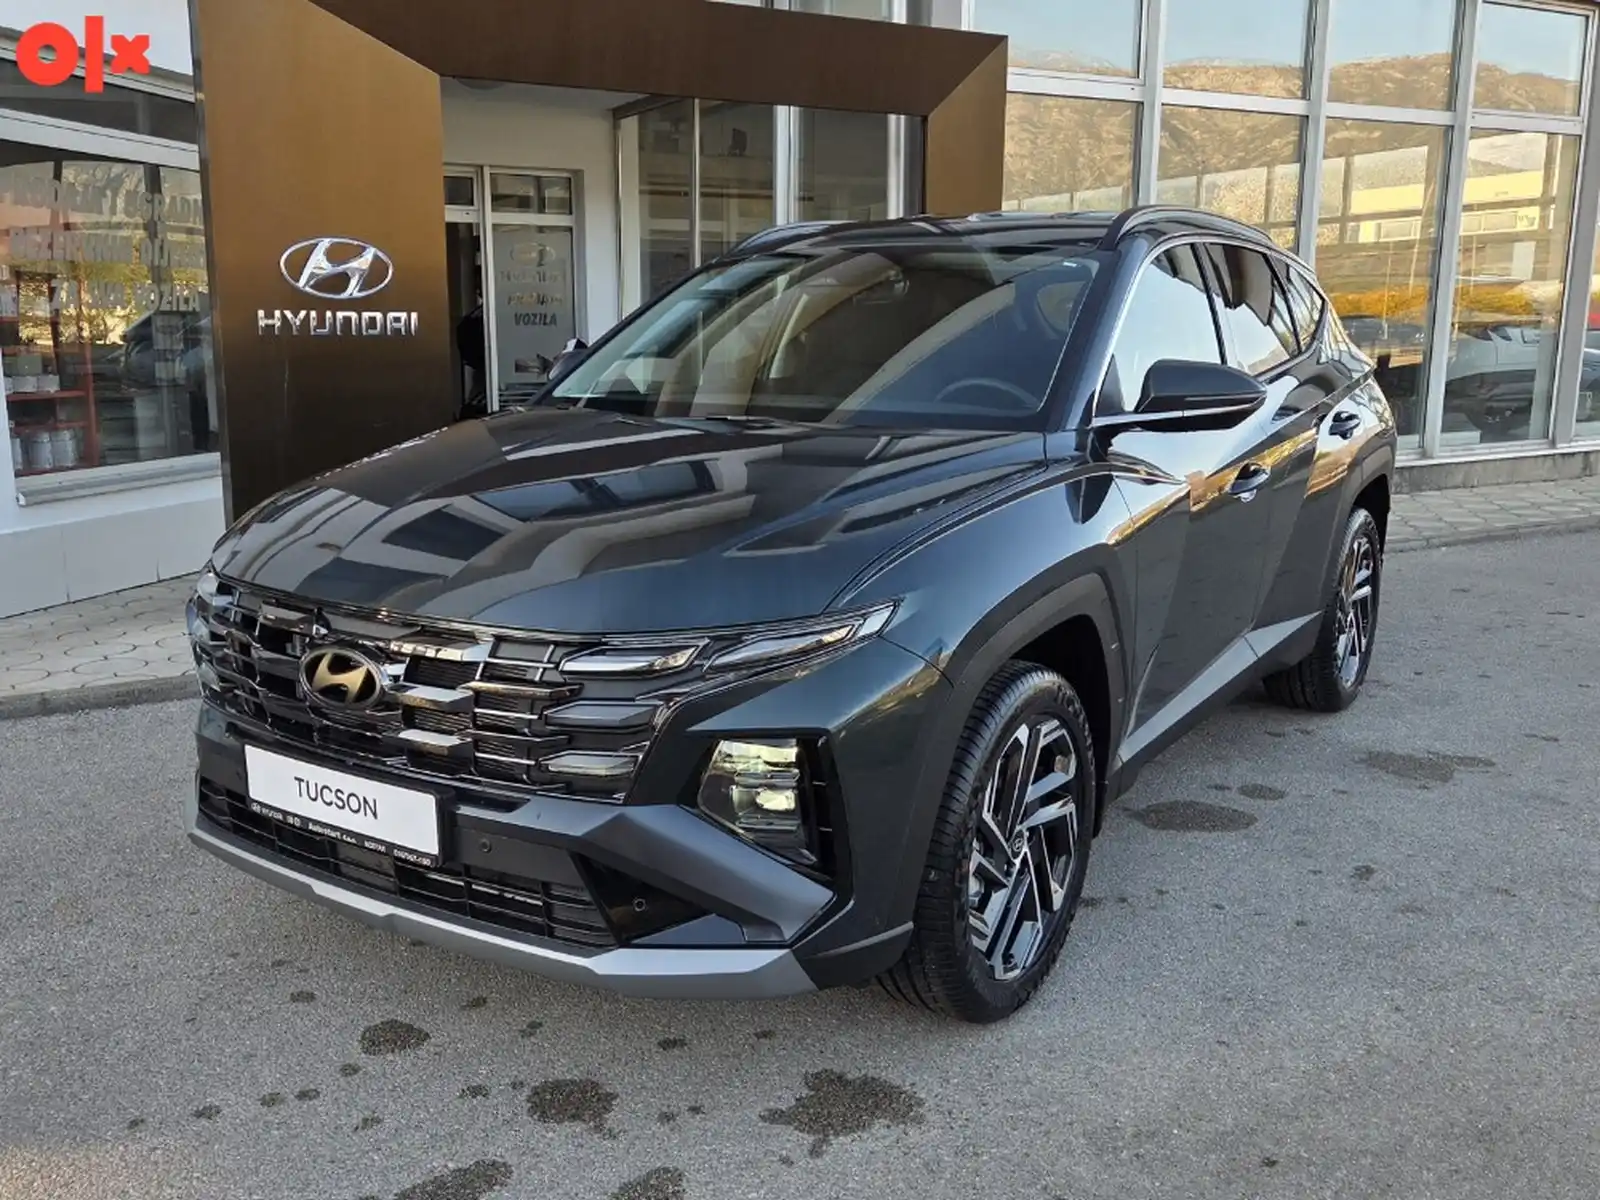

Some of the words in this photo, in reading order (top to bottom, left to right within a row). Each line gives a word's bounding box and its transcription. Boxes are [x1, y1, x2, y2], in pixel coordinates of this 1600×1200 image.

[134, 283, 201, 312] VOZILA
[257, 309, 419, 336] HYUNDAI
[514, 312, 557, 327] VOZILA
[294, 776, 378, 820] TUCSON
